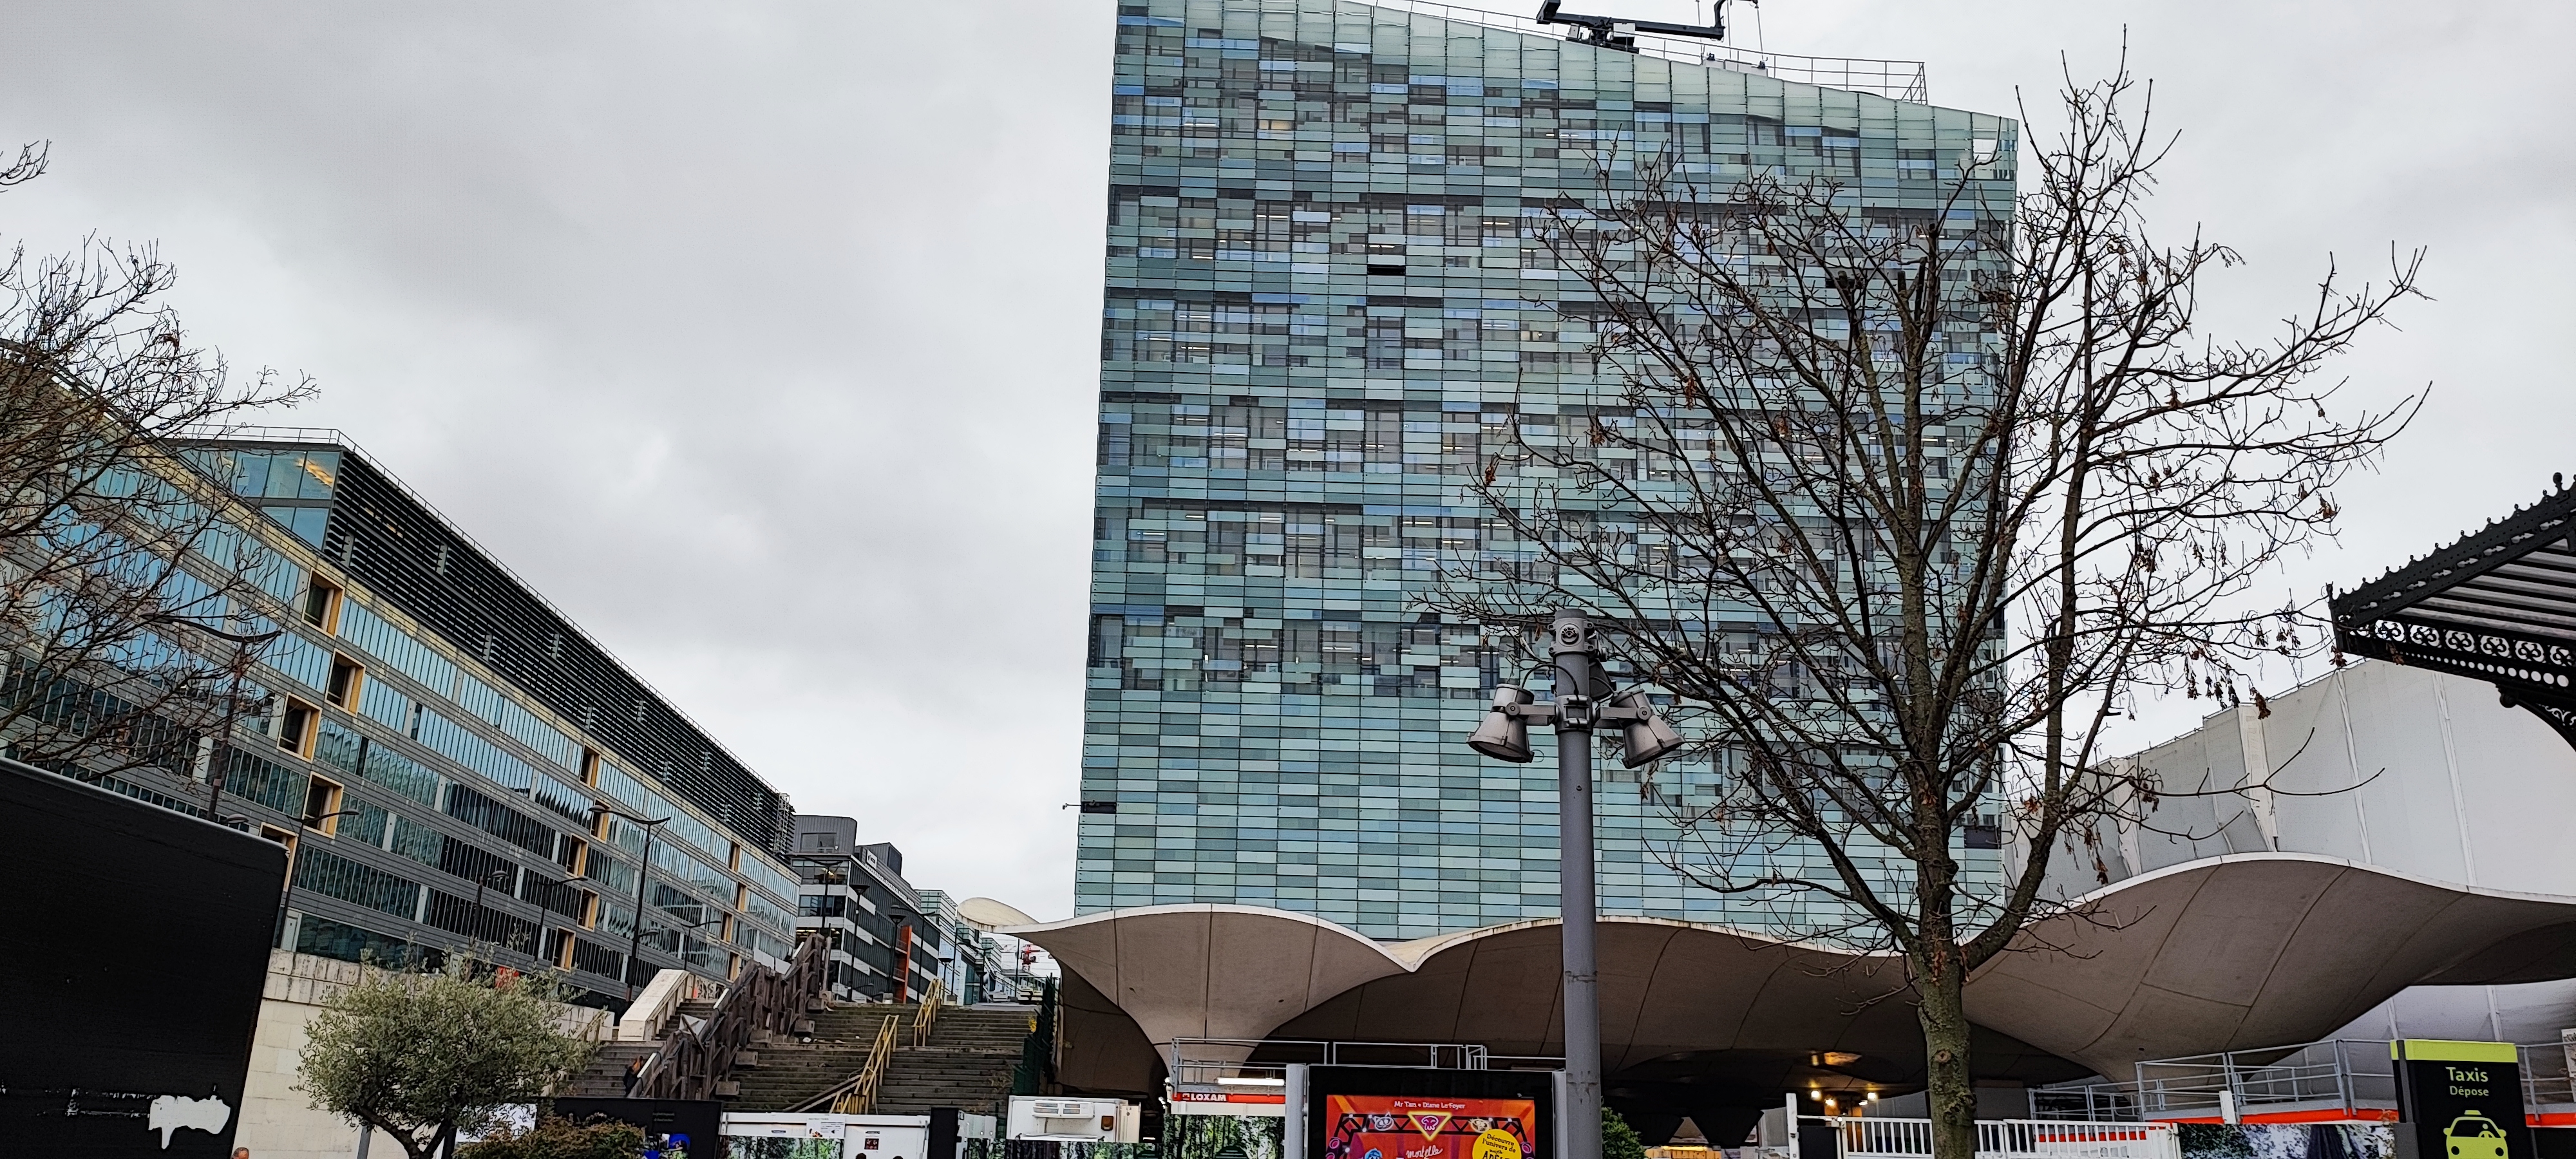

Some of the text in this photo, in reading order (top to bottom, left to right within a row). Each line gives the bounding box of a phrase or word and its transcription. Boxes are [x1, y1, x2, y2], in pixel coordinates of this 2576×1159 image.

[2445, 1066, 2488, 1082] Taxis
[2449, 1086, 2489, 1098] Dépose
[1482, 1138, 1507, 1150] l'univers
[1487, 1133, 1514, 1146] Découvre
